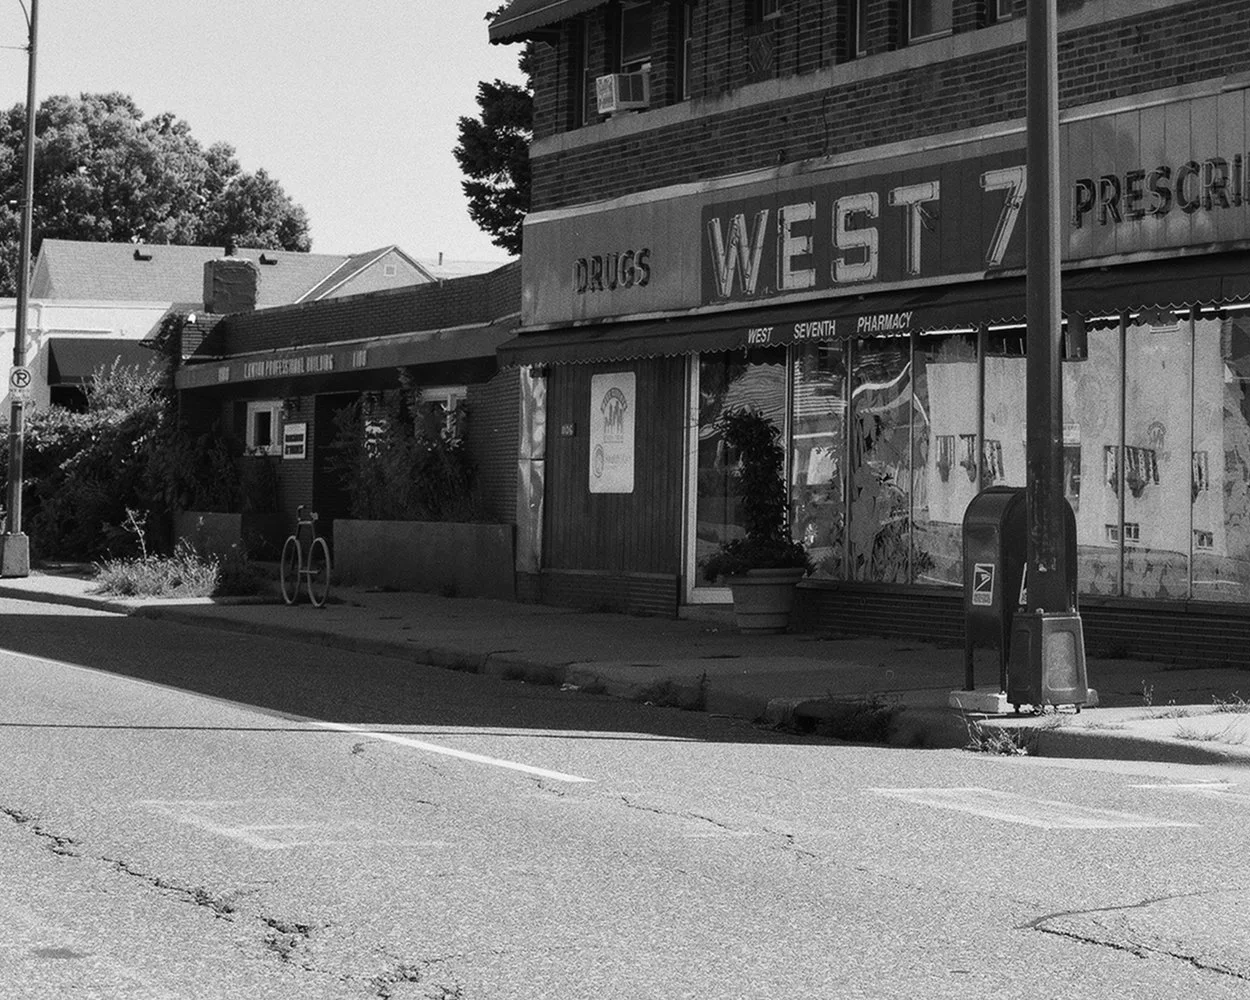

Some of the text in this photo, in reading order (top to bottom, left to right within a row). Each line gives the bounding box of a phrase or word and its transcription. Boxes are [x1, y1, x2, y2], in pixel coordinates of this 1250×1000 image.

[708, 164, 1027, 297] WEST 7
[572, 249, 651, 295] DRUGS
[748, 311, 913, 344] WEST SEVENTH PHARMACY
